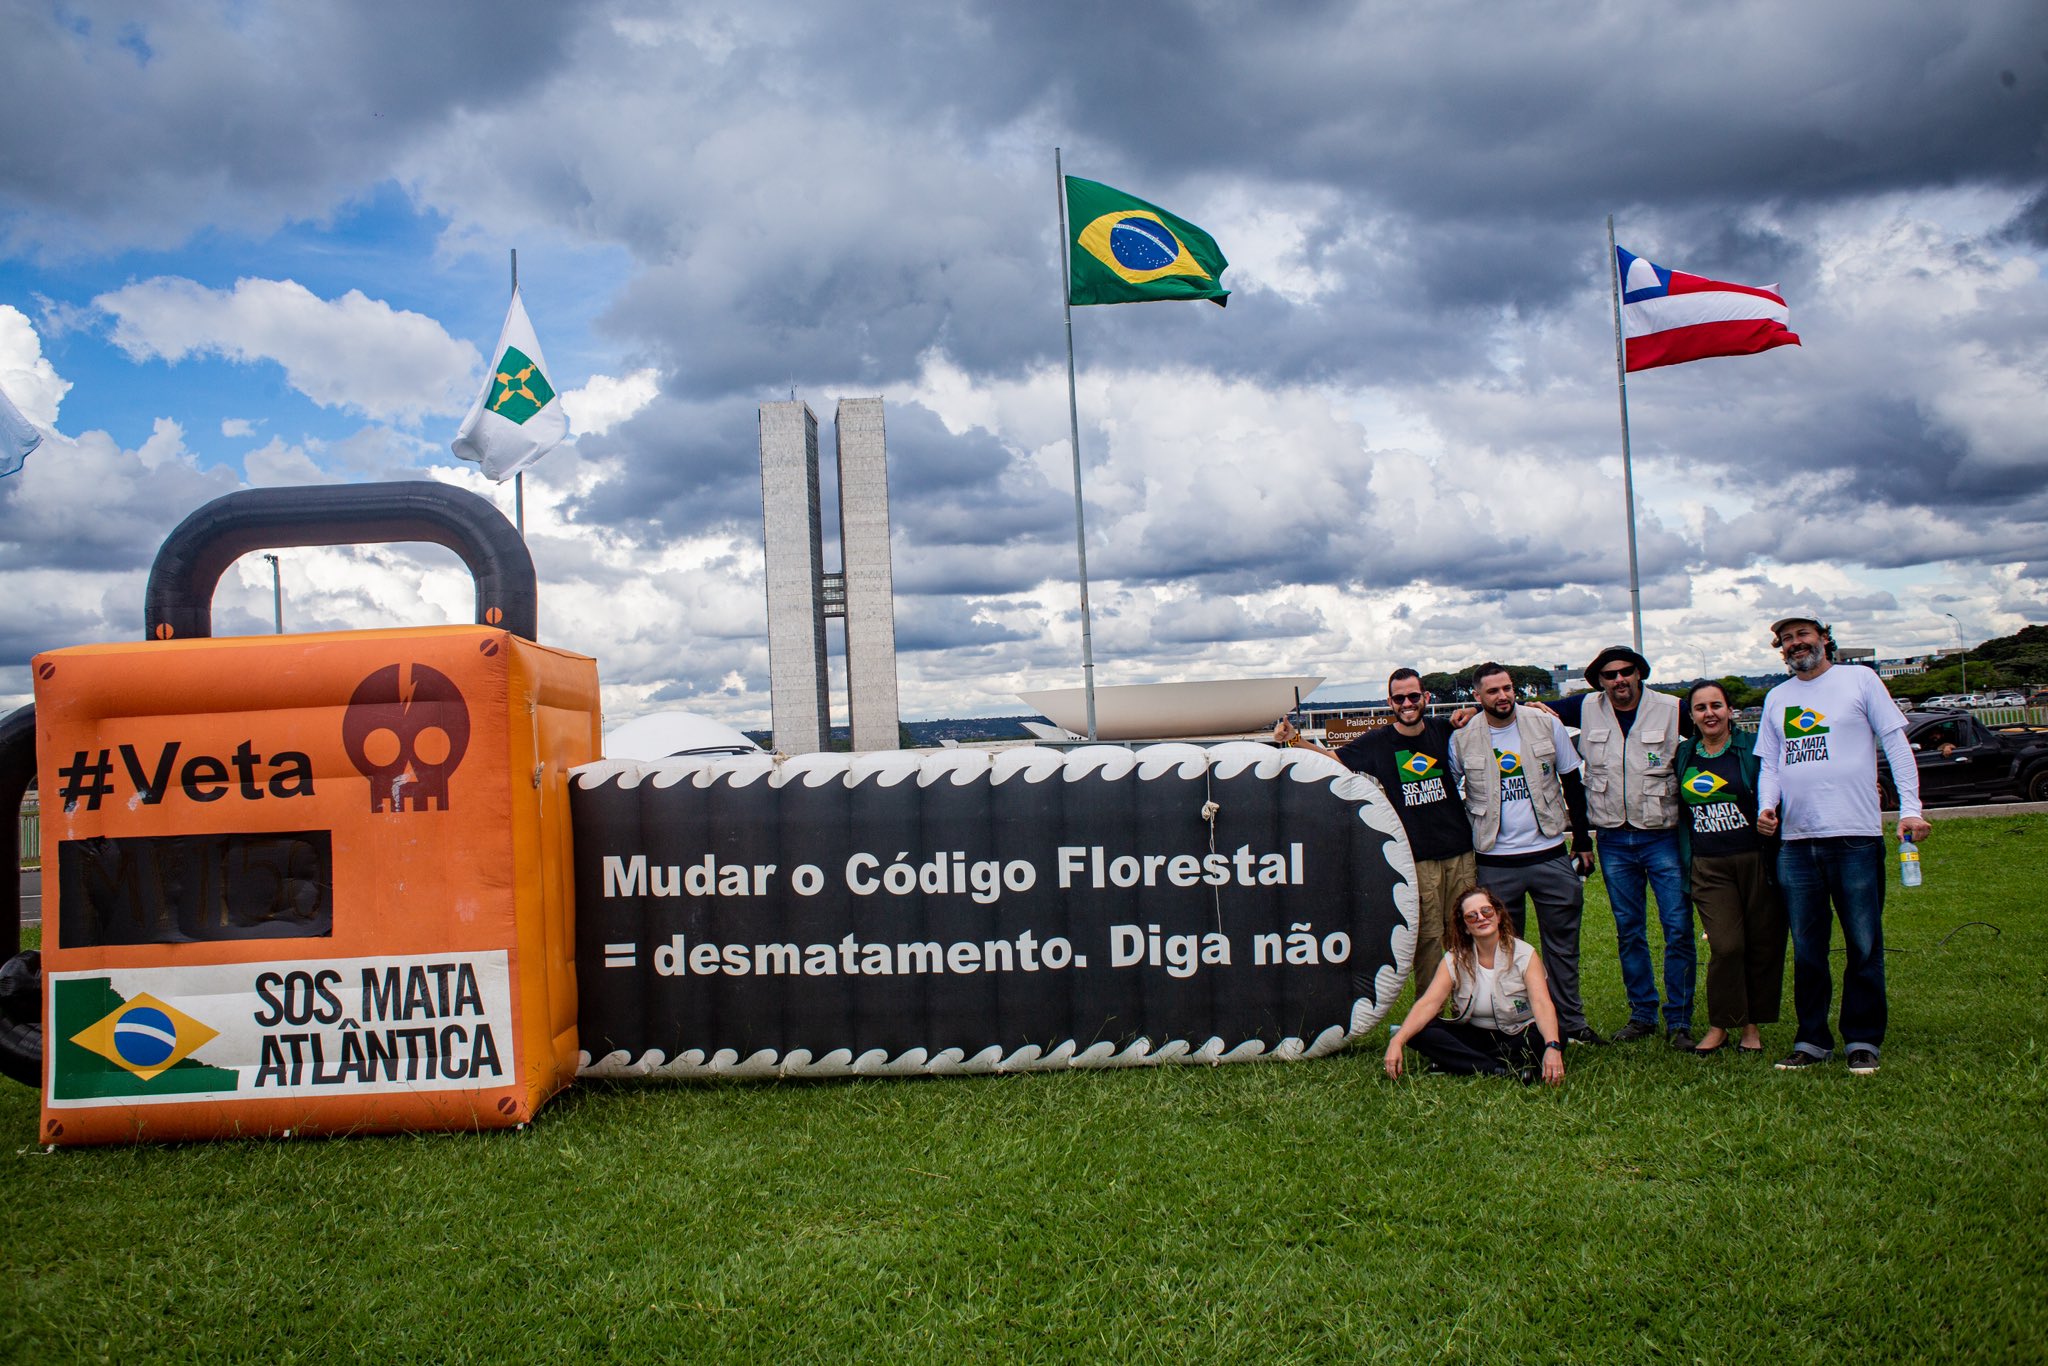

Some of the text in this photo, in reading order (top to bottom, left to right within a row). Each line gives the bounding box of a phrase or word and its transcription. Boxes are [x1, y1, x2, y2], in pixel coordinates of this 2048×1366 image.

[1346, 717, 1388, 727] Palácio do
[1801, 735, 1826, 750] MATA
[59, 740, 315, 812] #Veta
[1402, 777, 1443, 795] SOS MATA
[1706, 802, 1740, 819] MATA
[604, 842, 1303, 903] Mudar o Código Florestal
[604, 923, 1351, 977] = desmatamento. Diga não
[254, 963, 485, 1028] SOS MATA
[254, 1019, 502, 1087] ATLÂNTICA
